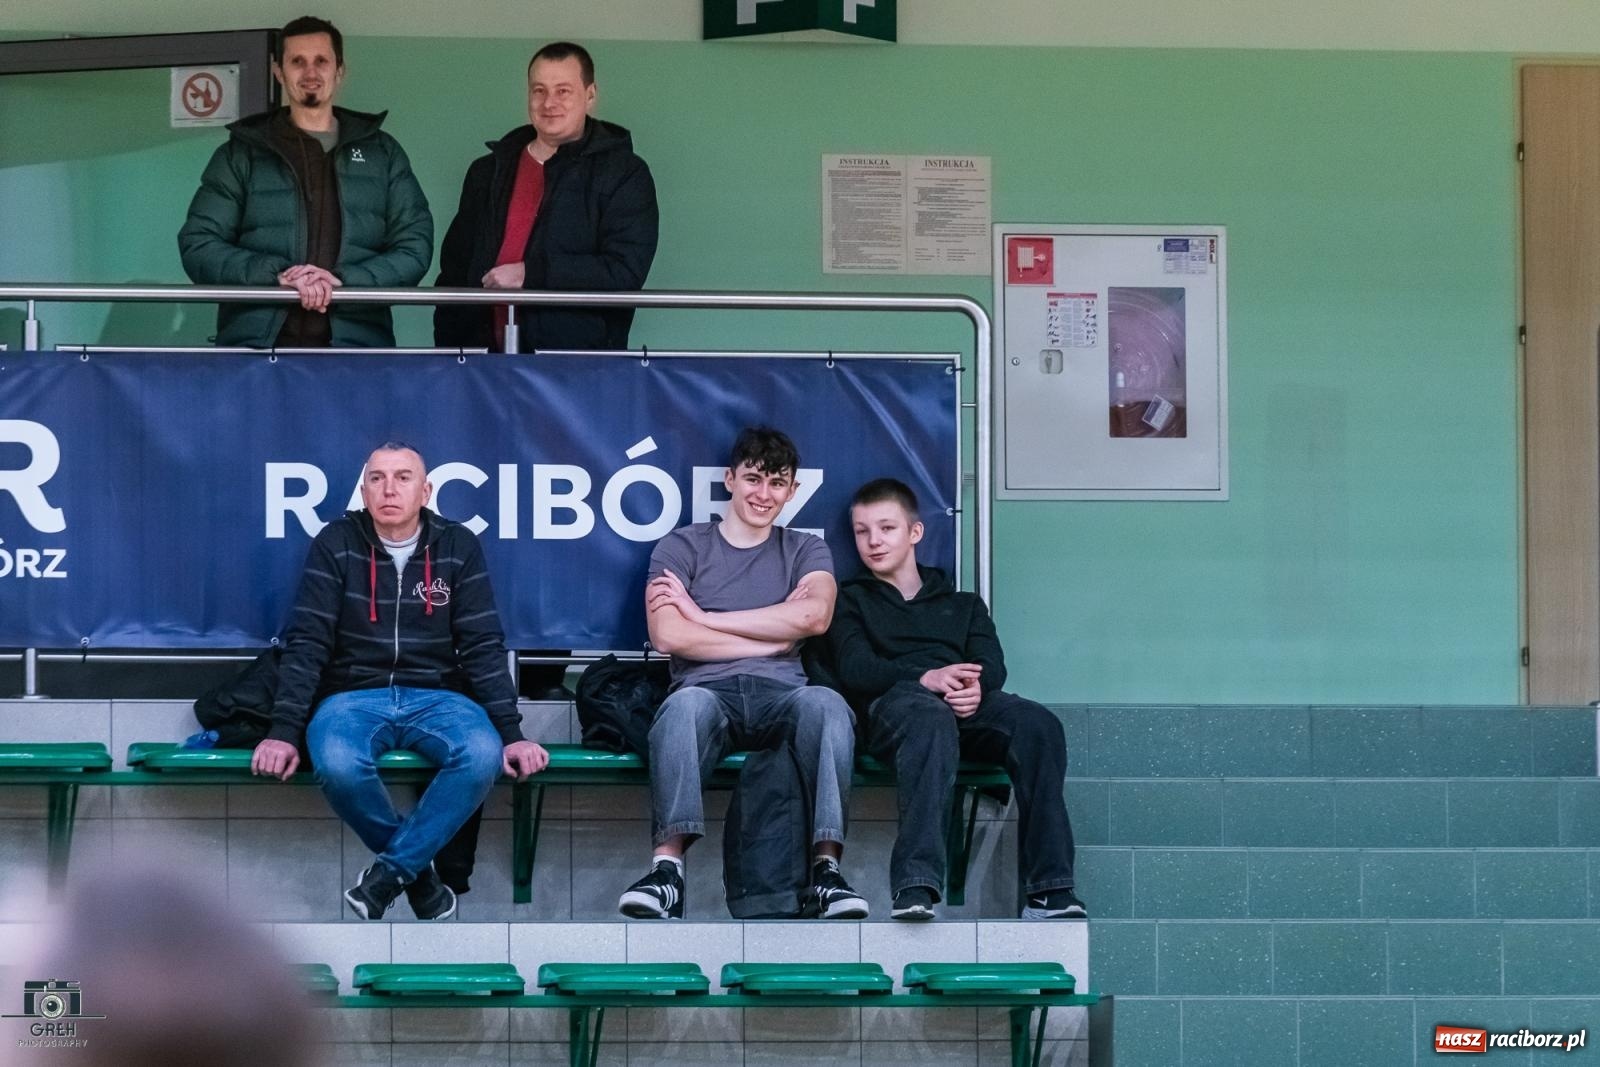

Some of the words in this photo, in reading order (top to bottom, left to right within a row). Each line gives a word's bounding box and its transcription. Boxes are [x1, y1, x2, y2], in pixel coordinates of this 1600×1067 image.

[839, 158, 890, 166] INSTRUKCJA
[924, 159, 975, 169] INSTRUKCJA
[265, 436, 825, 543] RCIBÓZ
